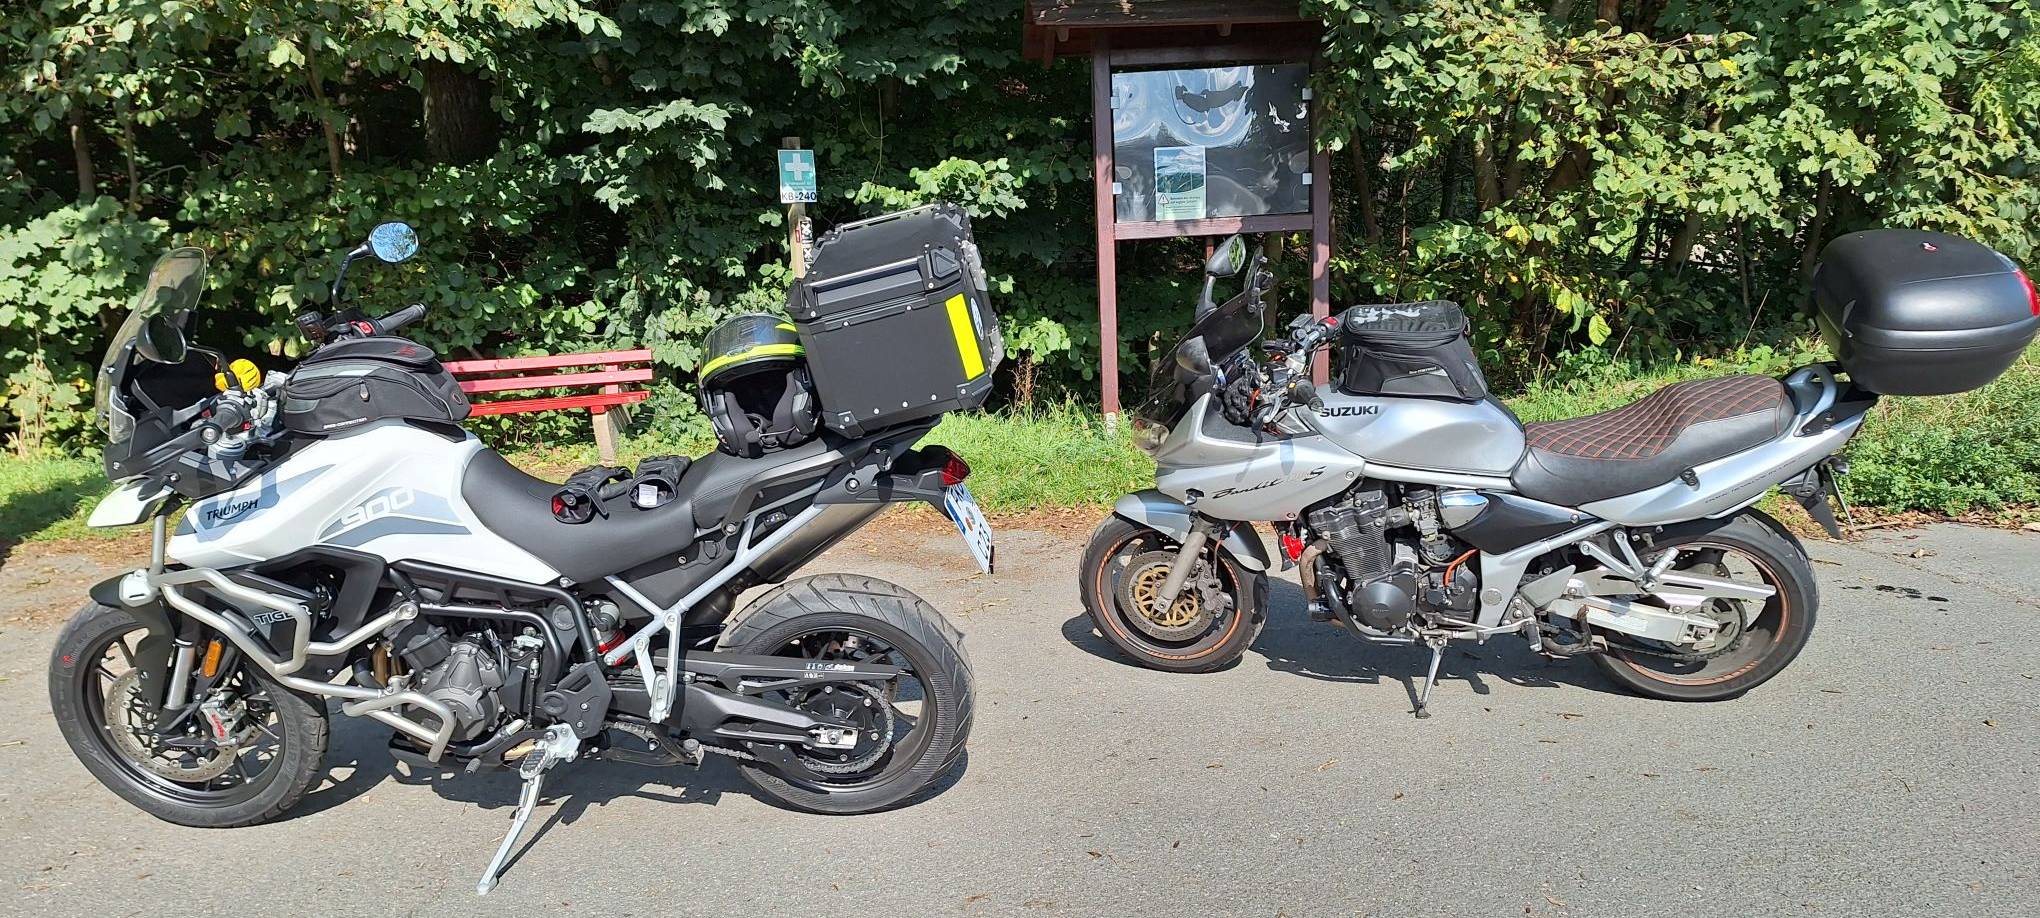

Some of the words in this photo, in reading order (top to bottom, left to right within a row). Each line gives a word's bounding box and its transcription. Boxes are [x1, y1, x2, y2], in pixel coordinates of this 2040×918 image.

[781, 191, 817, 201] KB-240
[1319, 405, 1379, 418] SUZUKI
[1211, 478, 1285, 500] Bandit
[206, 500, 259, 520] TRIUMPH
[341, 487, 415, 527] 900
[253, 605, 313, 625] TIG
